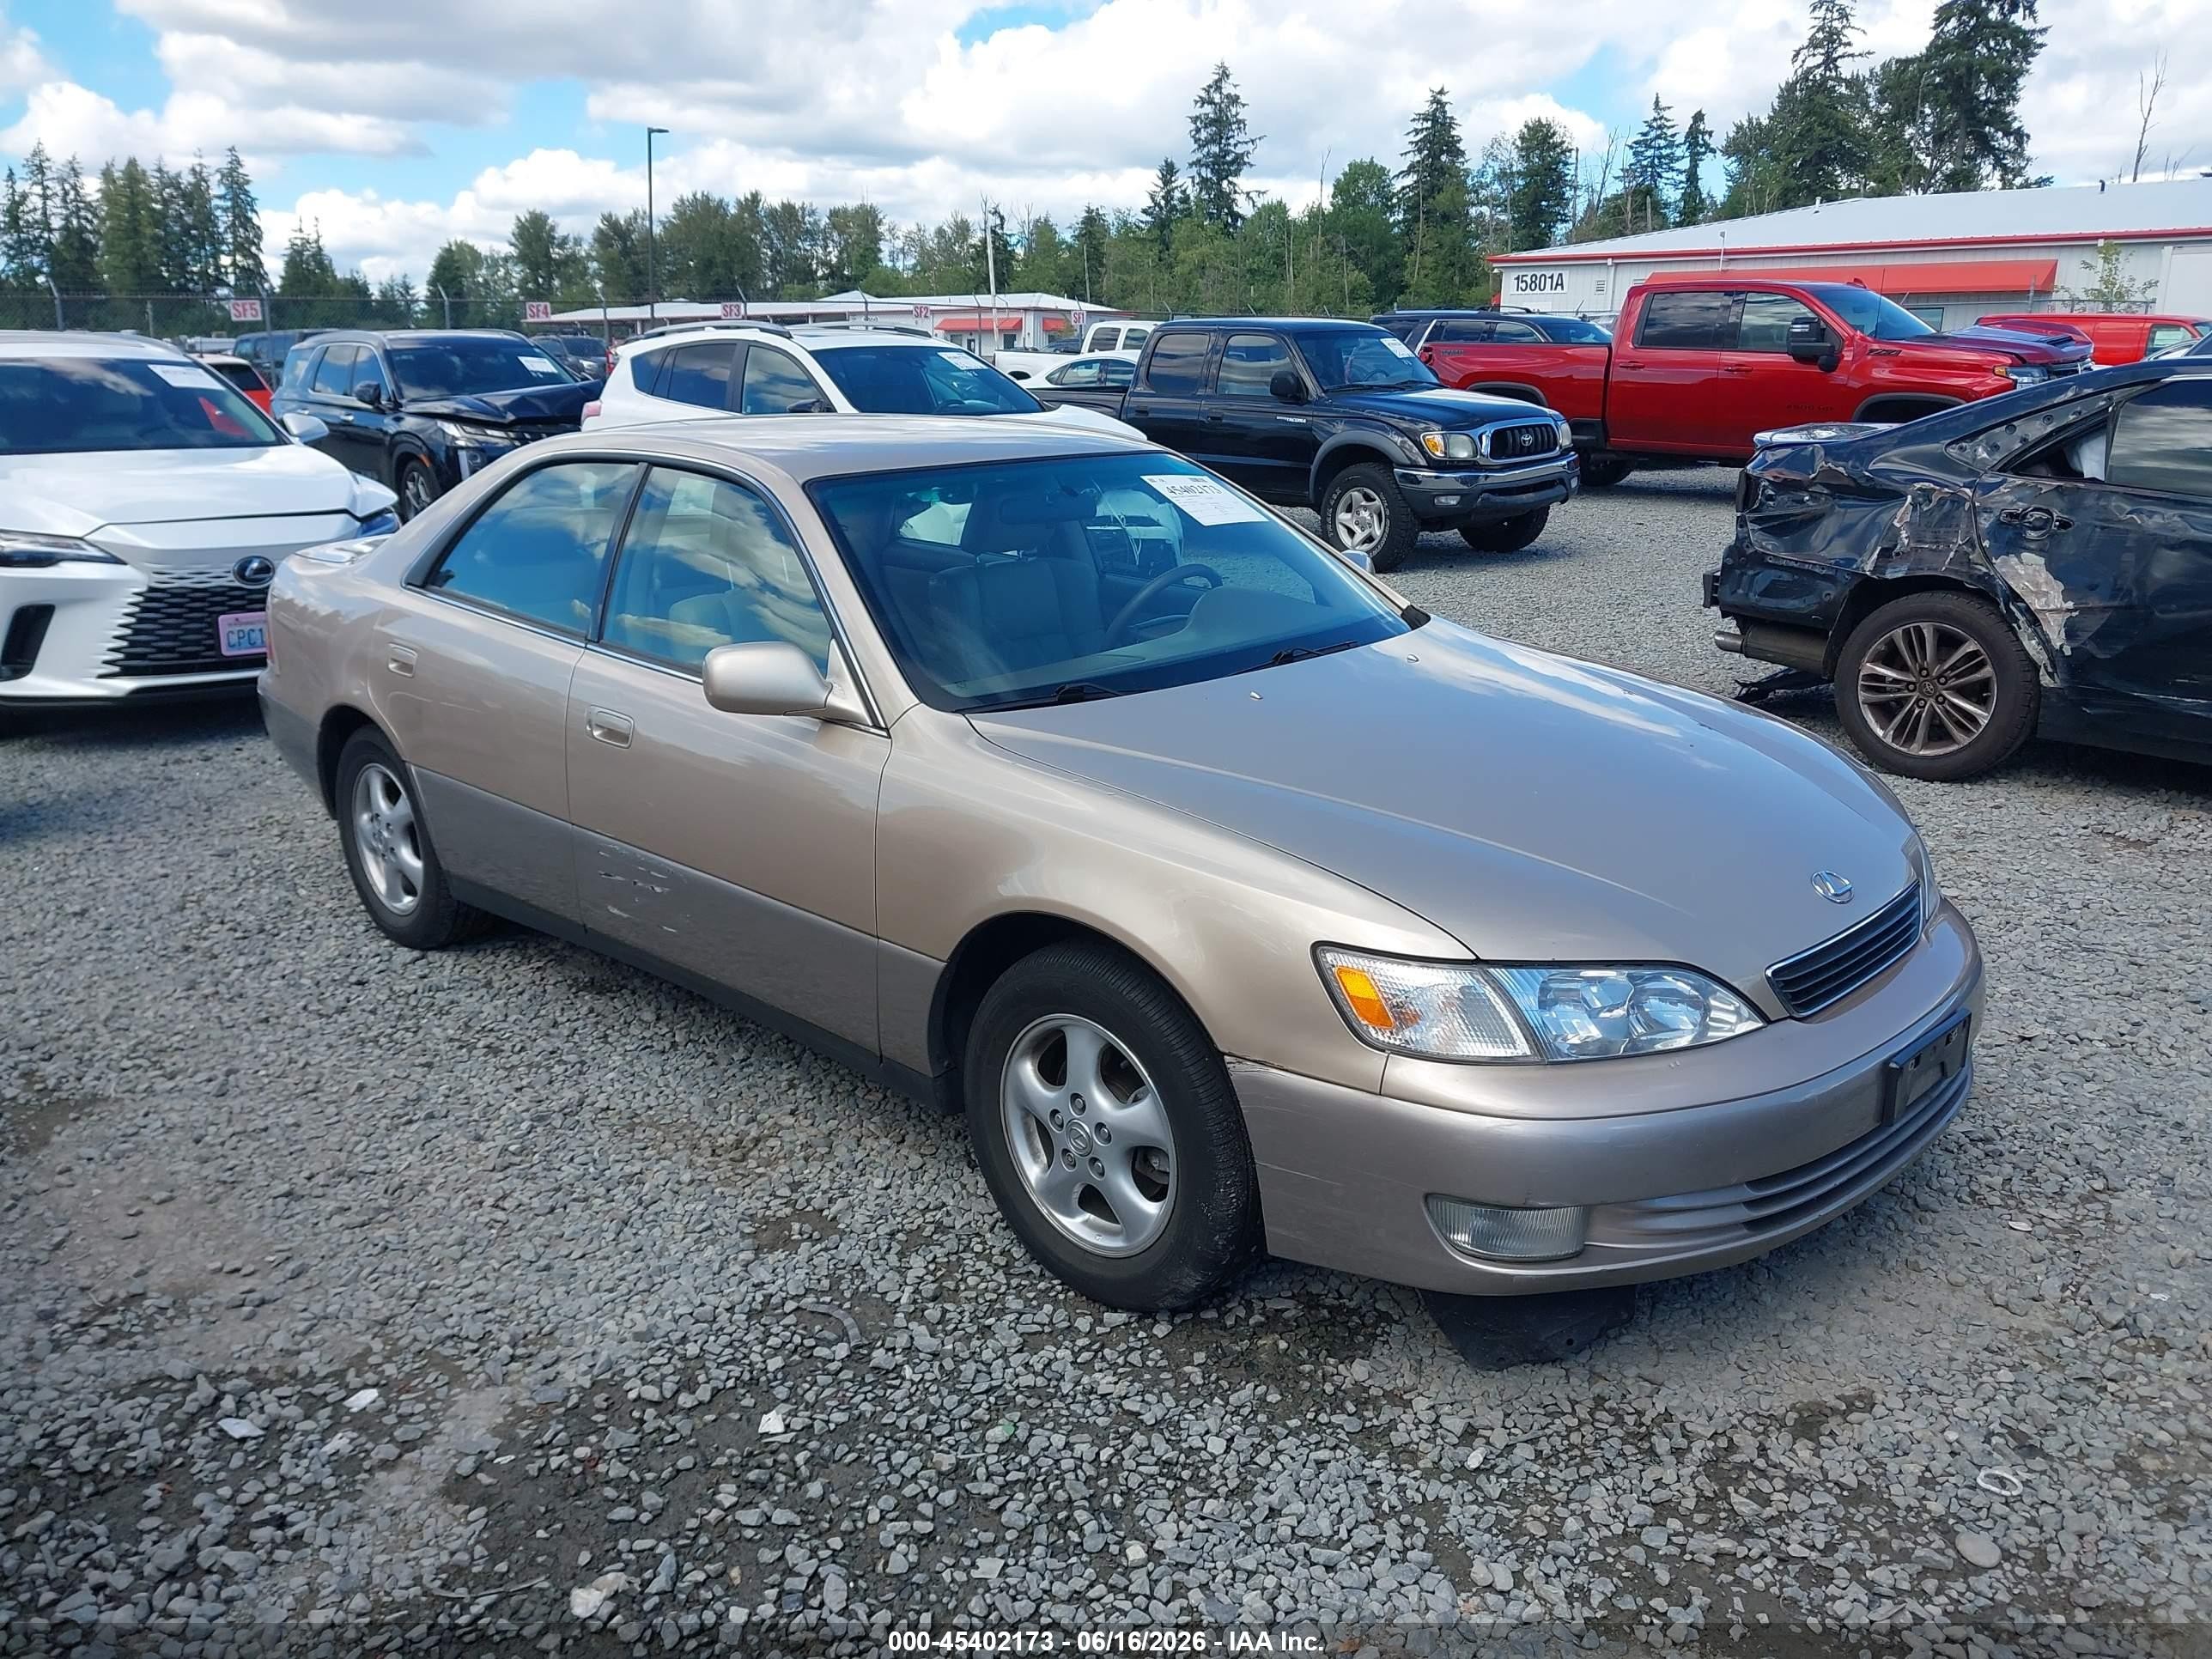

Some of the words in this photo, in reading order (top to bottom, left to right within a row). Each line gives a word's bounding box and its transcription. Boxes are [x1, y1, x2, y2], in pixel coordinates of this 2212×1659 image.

[1513, 272, 1565, 292] 15801A
[233, 301, 259, 318] SF5
[528, 303, 549, 318] SF4
[722, 304, 740, 318] SF3
[914, 306, 929, 318] SF2
[1073, 312, 1085, 324] SF1
[226, 628, 265, 648] CPC1
